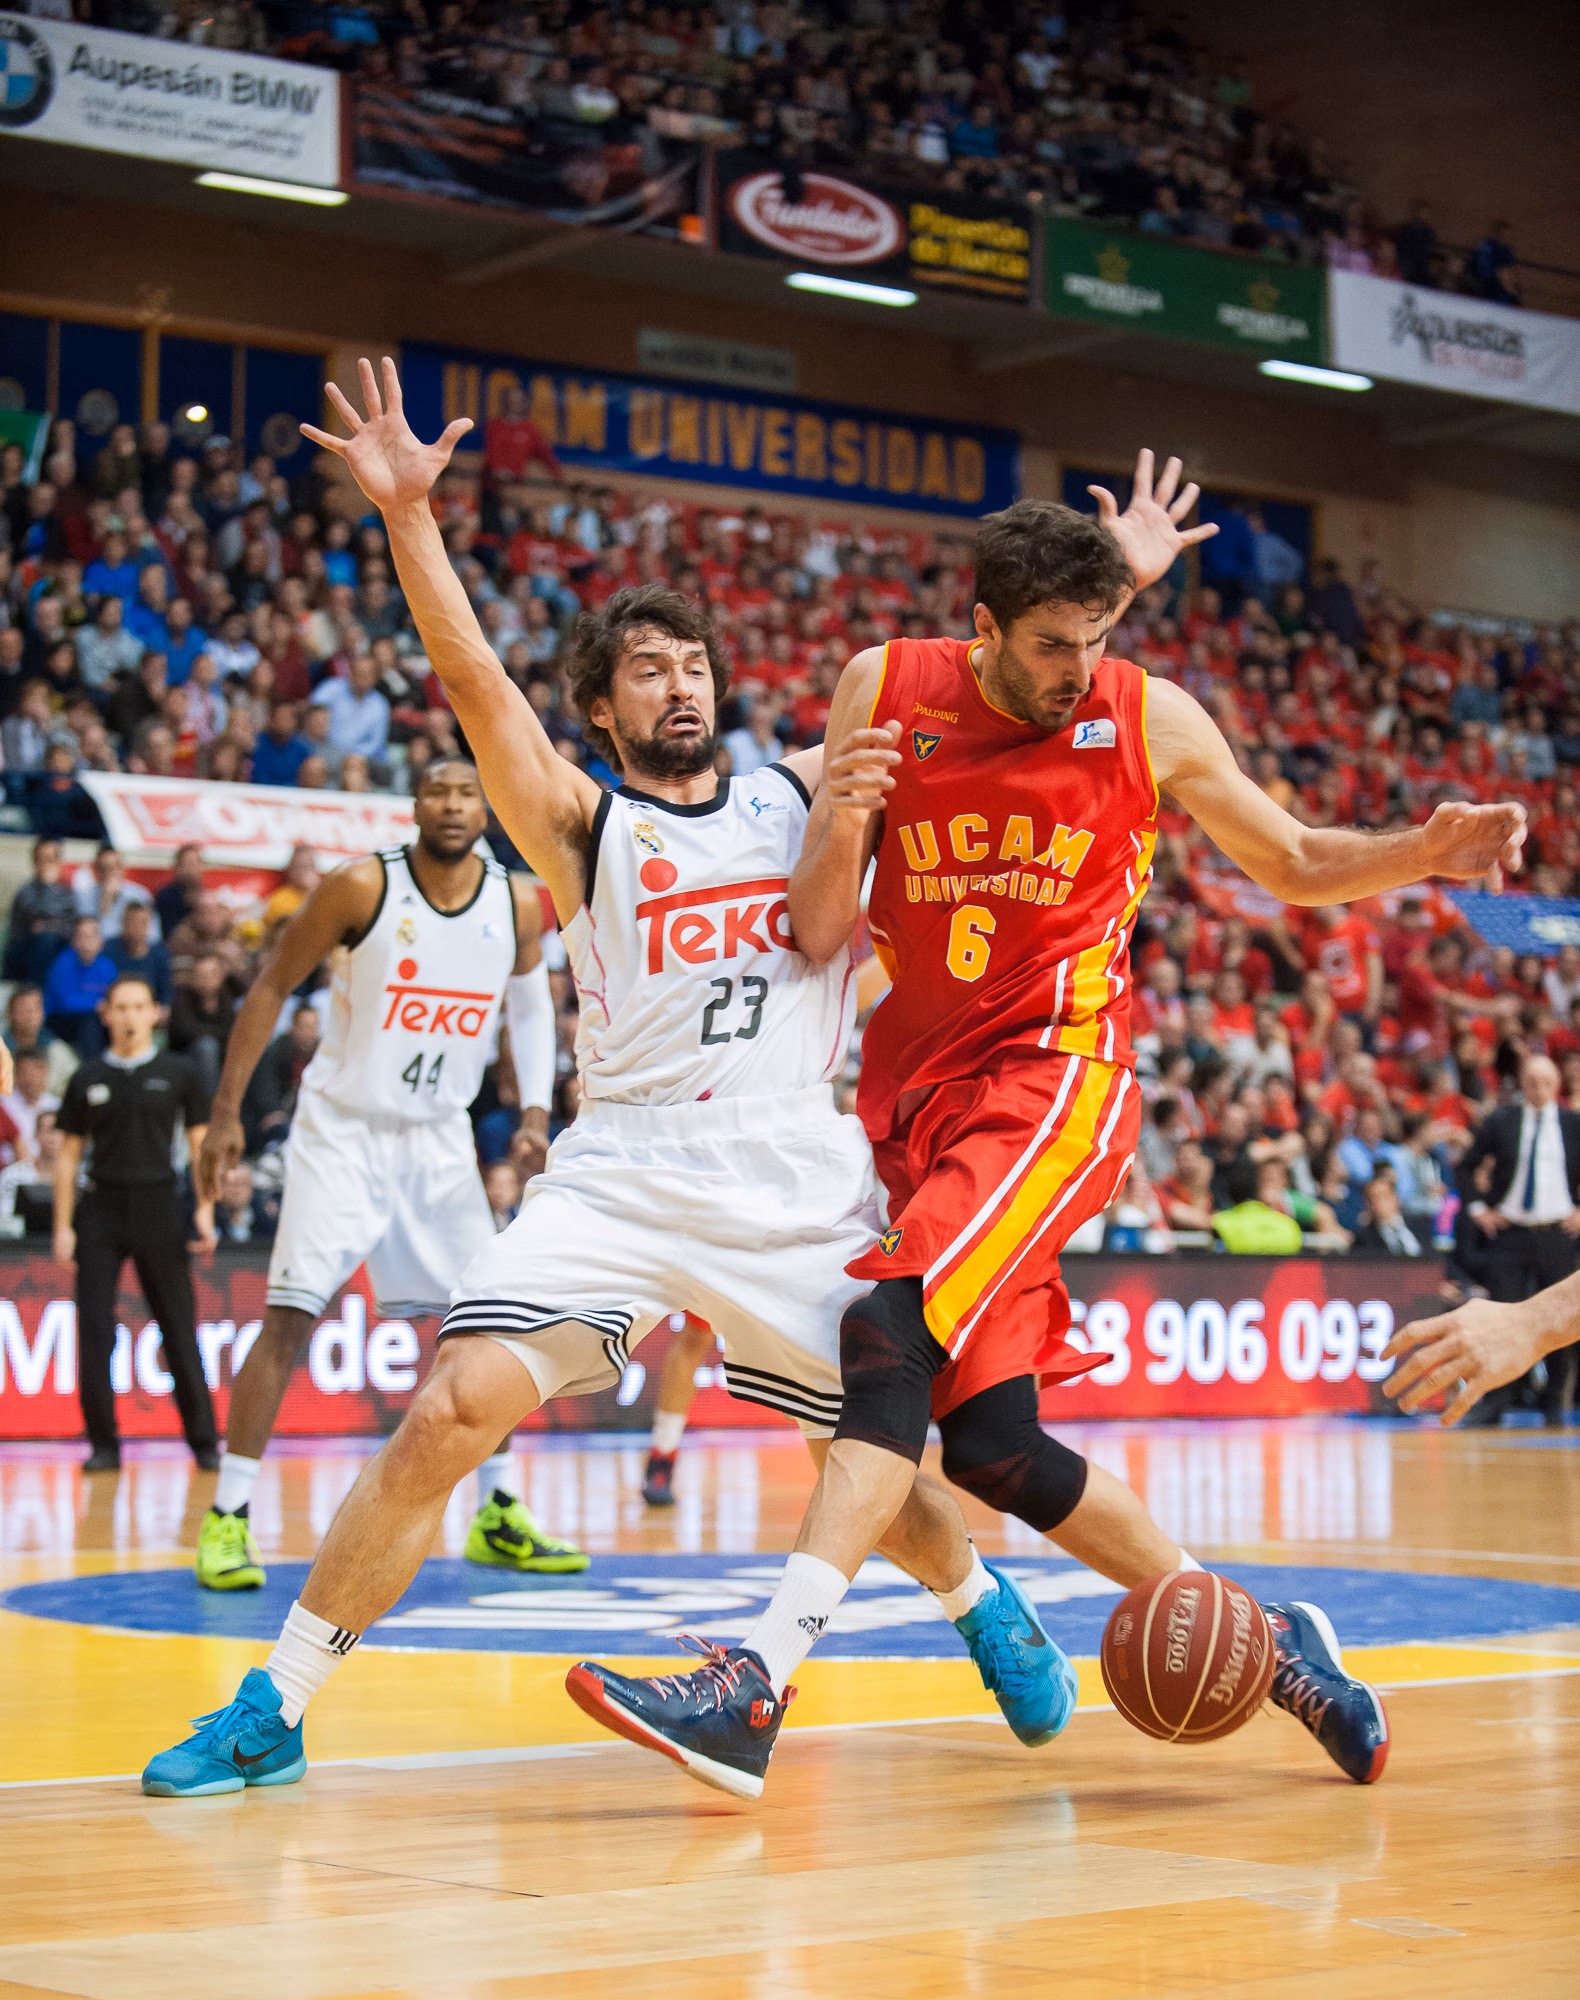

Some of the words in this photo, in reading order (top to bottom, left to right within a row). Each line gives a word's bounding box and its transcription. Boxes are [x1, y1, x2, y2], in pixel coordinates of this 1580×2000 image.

[67, 43, 223, 101] Aupesán
[230, 71, 321, 115] BMW
[628, 388, 986, 505] UNIVERSIDAD
[898, 813, 1096, 878] UCAM
[946, 904, 997, 982] 6
[383, 985, 495, 1037] Teka
[701, 975, 768, 1045] 23
[402, 1053, 444, 1094] 44
[309, 1294, 418, 1395] de
[1144, 1298, 1268, 1384] 906
[1279, 1298, 1396, 1382] 093
[1205, 1586, 1252, 1706] SPALDING
